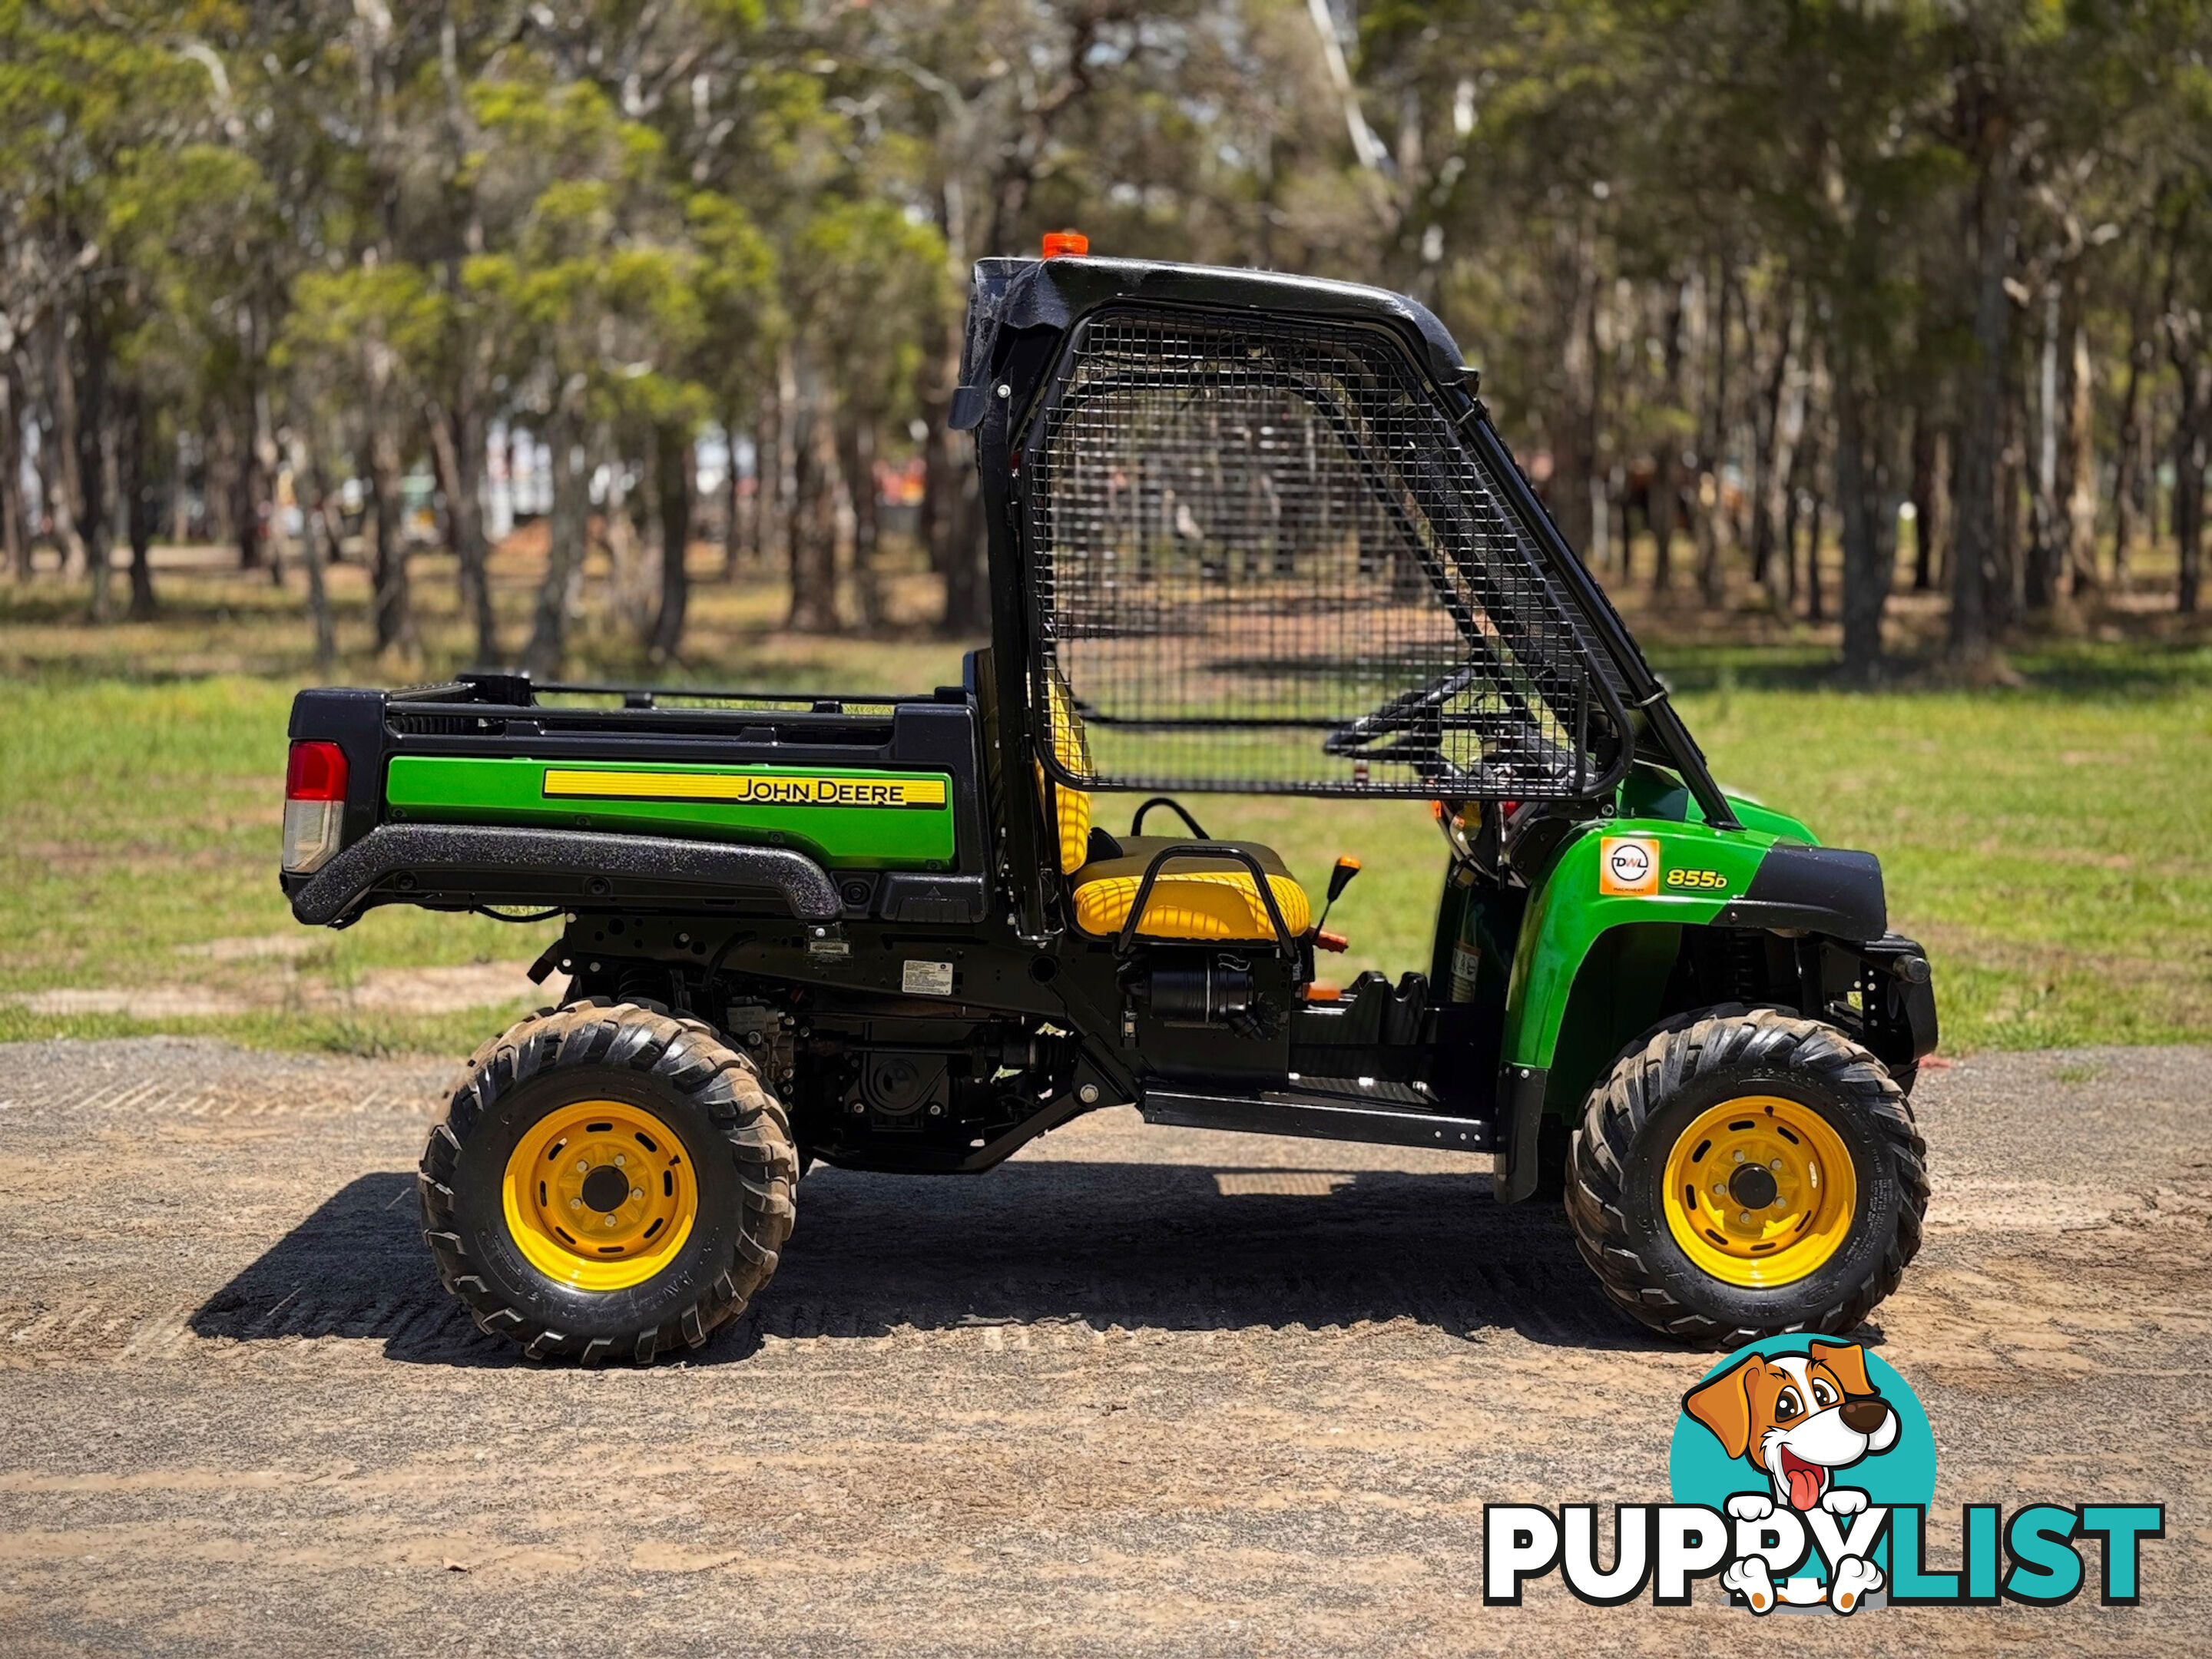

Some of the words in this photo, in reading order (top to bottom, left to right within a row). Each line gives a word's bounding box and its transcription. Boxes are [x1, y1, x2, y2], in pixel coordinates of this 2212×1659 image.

[738, 779, 810, 800] JOHN
[817, 780, 905, 803] DEERE
[1666, 869, 1728, 888] 855D
